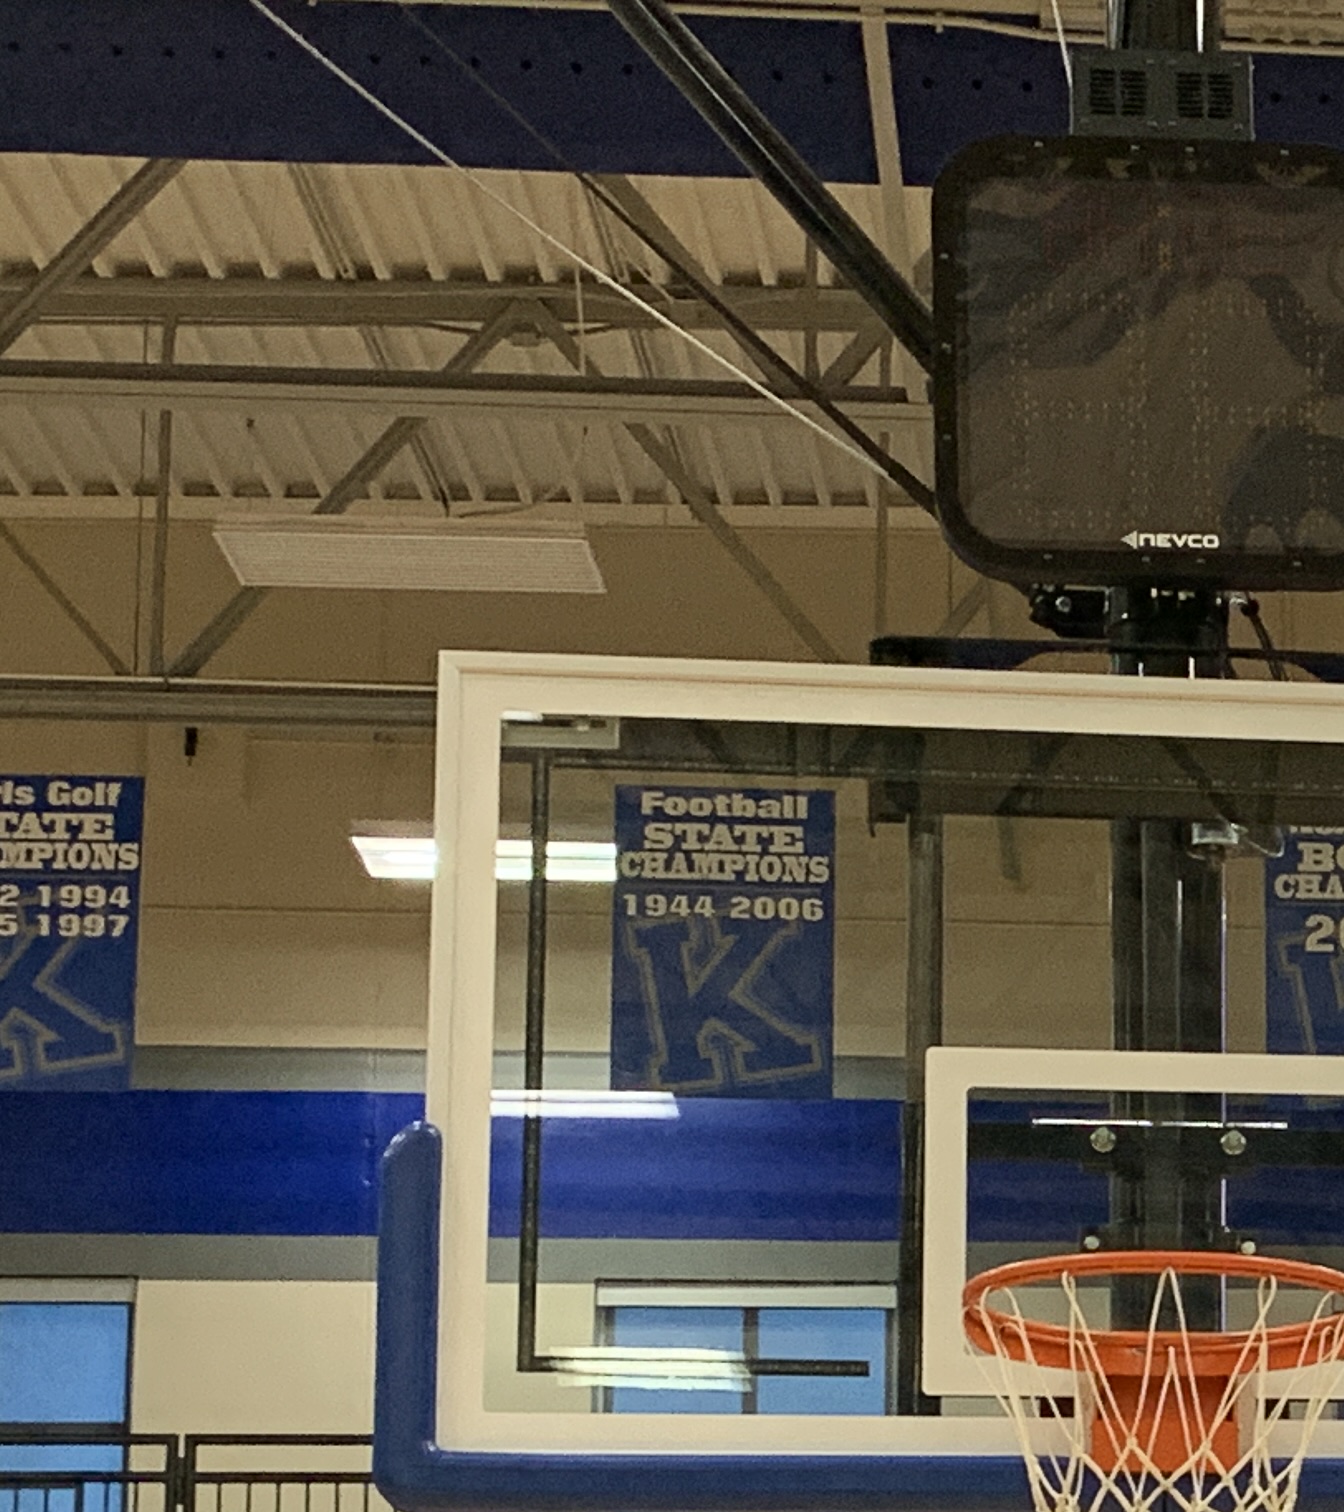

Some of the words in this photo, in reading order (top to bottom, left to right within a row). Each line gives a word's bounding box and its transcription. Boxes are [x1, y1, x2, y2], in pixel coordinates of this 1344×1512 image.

[47, 781, 122, 807] Golf
[641, 791, 808, 820] Football
[643, 822, 805, 854] STATE
[620, 852, 830, 884] CHAMPIONS
[37, 884, 131, 908] 1994
[623, 894, 716, 918] 1944
[730, 896, 825, 921] 2006
[36, 913, 130, 937] 1997
